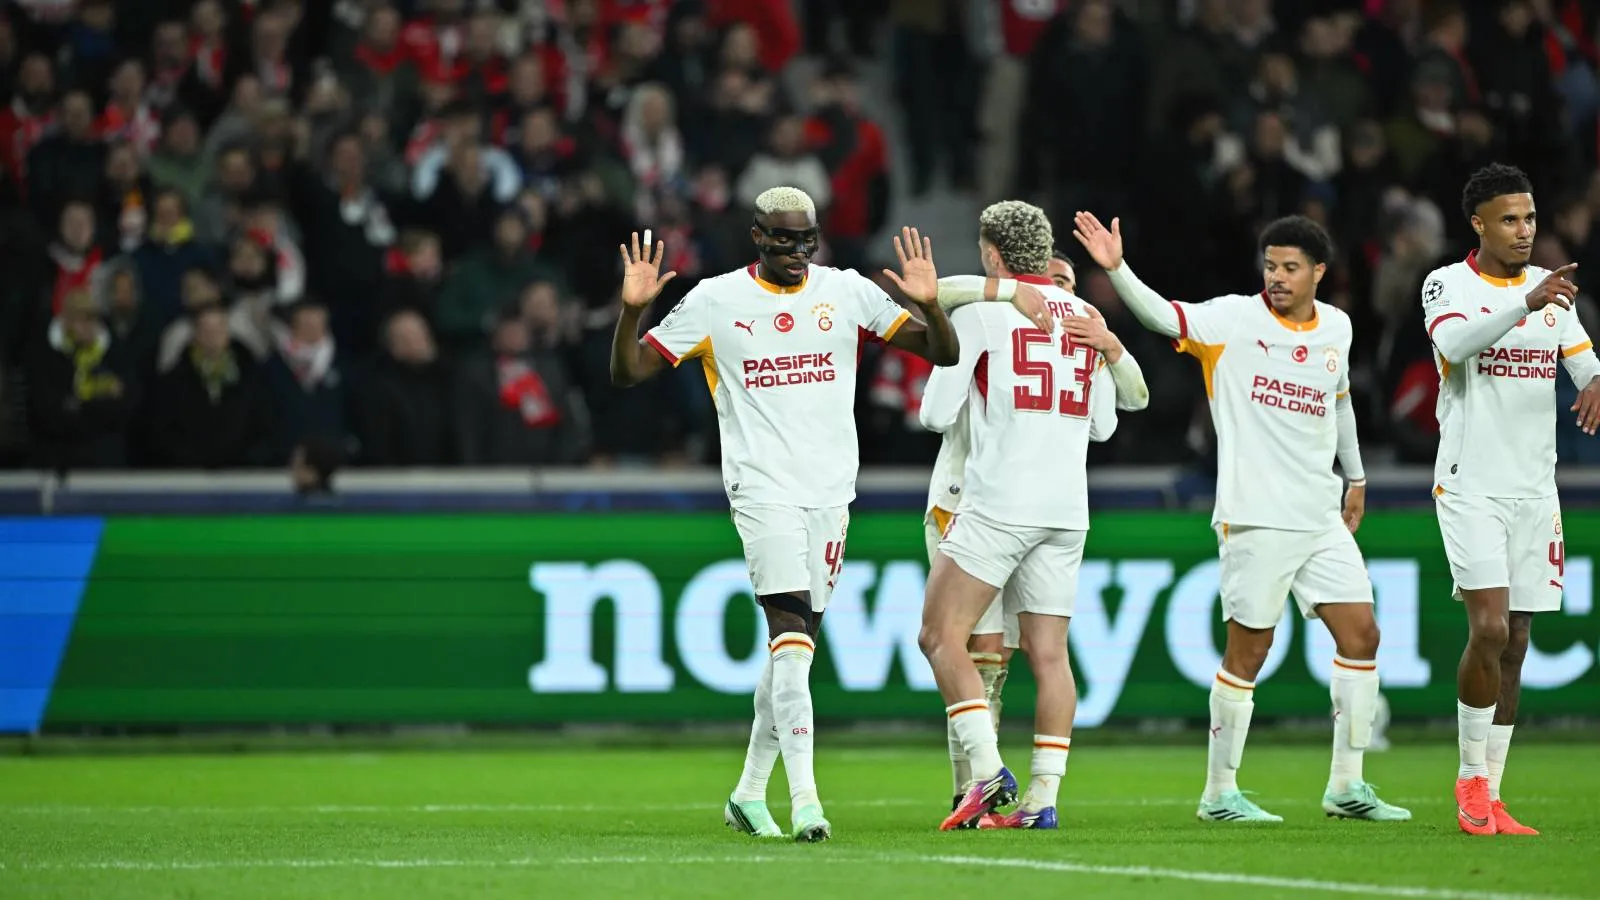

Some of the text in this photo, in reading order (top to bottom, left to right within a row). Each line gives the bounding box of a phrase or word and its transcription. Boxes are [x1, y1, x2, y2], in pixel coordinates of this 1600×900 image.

[1011, 328, 1097, 417] 53
[528, 558, 949, 694] now
[1062, 557, 1432, 728] you
[792, 727, 808, 735] GS
